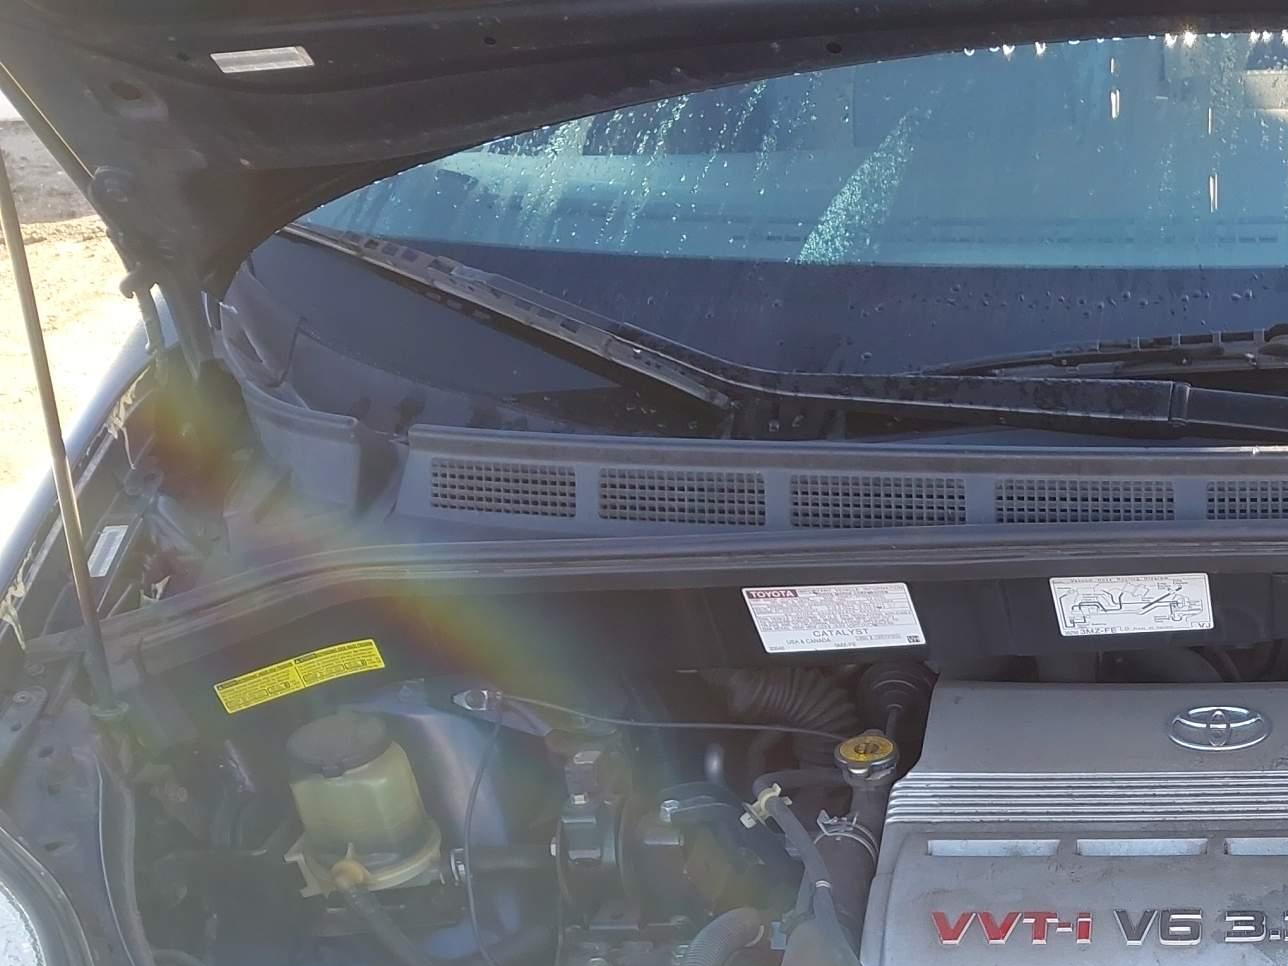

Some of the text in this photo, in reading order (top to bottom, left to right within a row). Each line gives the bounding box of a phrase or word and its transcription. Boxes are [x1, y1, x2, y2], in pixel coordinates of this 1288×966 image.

[750, 590, 794, 598] TOYOTA
[812, 628, 869, 637] CATALYST
[930, 910, 1093, 945] VVT-i
[1113, 908, 1203, 946] V6
